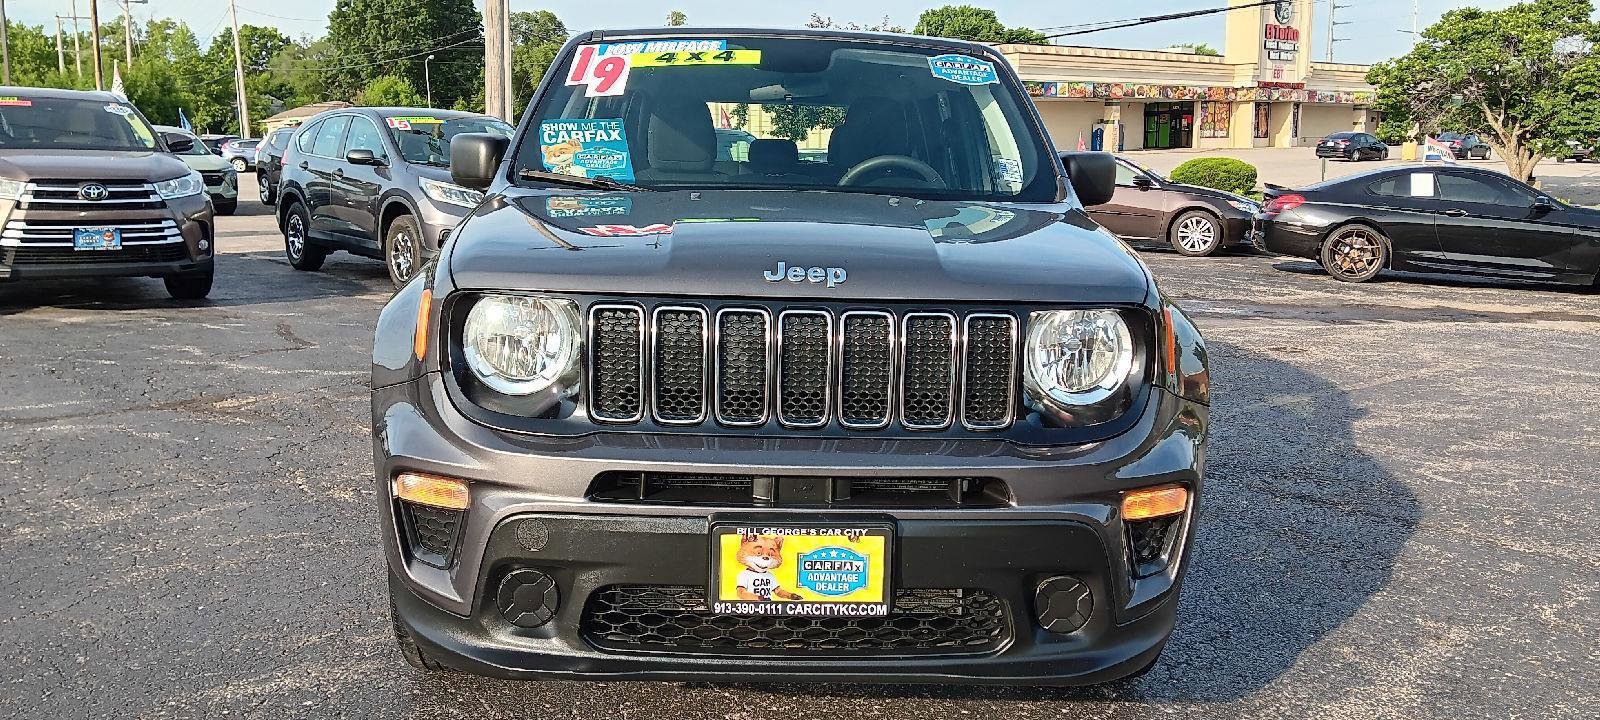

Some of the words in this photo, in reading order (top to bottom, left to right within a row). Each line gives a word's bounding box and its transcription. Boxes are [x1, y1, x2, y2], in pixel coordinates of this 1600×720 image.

[571, 46, 626, 93] 19
[935, 61, 989, 72] CARFAX
[941, 69, 989, 77] ADVANTAGE
[1273, 69, 1284, 79] EBT
[542, 123, 577, 131] SHOW
[581, 122, 597, 130] ME
[599, 122, 620, 130] THE
[543, 130, 622, 143] CARFAX
[763, 261, 848, 288] Jeep
[737, 528, 758, 536] BILL
[762, 528, 817, 536] GEORGE'S
[803, 561, 863, 571] CARFAX
[807, 573, 859, 582] ADVANTAGE
[753, 578, 771, 587] CAR
[815, 583, 850, 592] DEALER
[753, 588, 771, 597] FOX
[714, 603, 782, 615] 913-390-0111
[786, 603, 888, 616] CARCITYKC.COM
